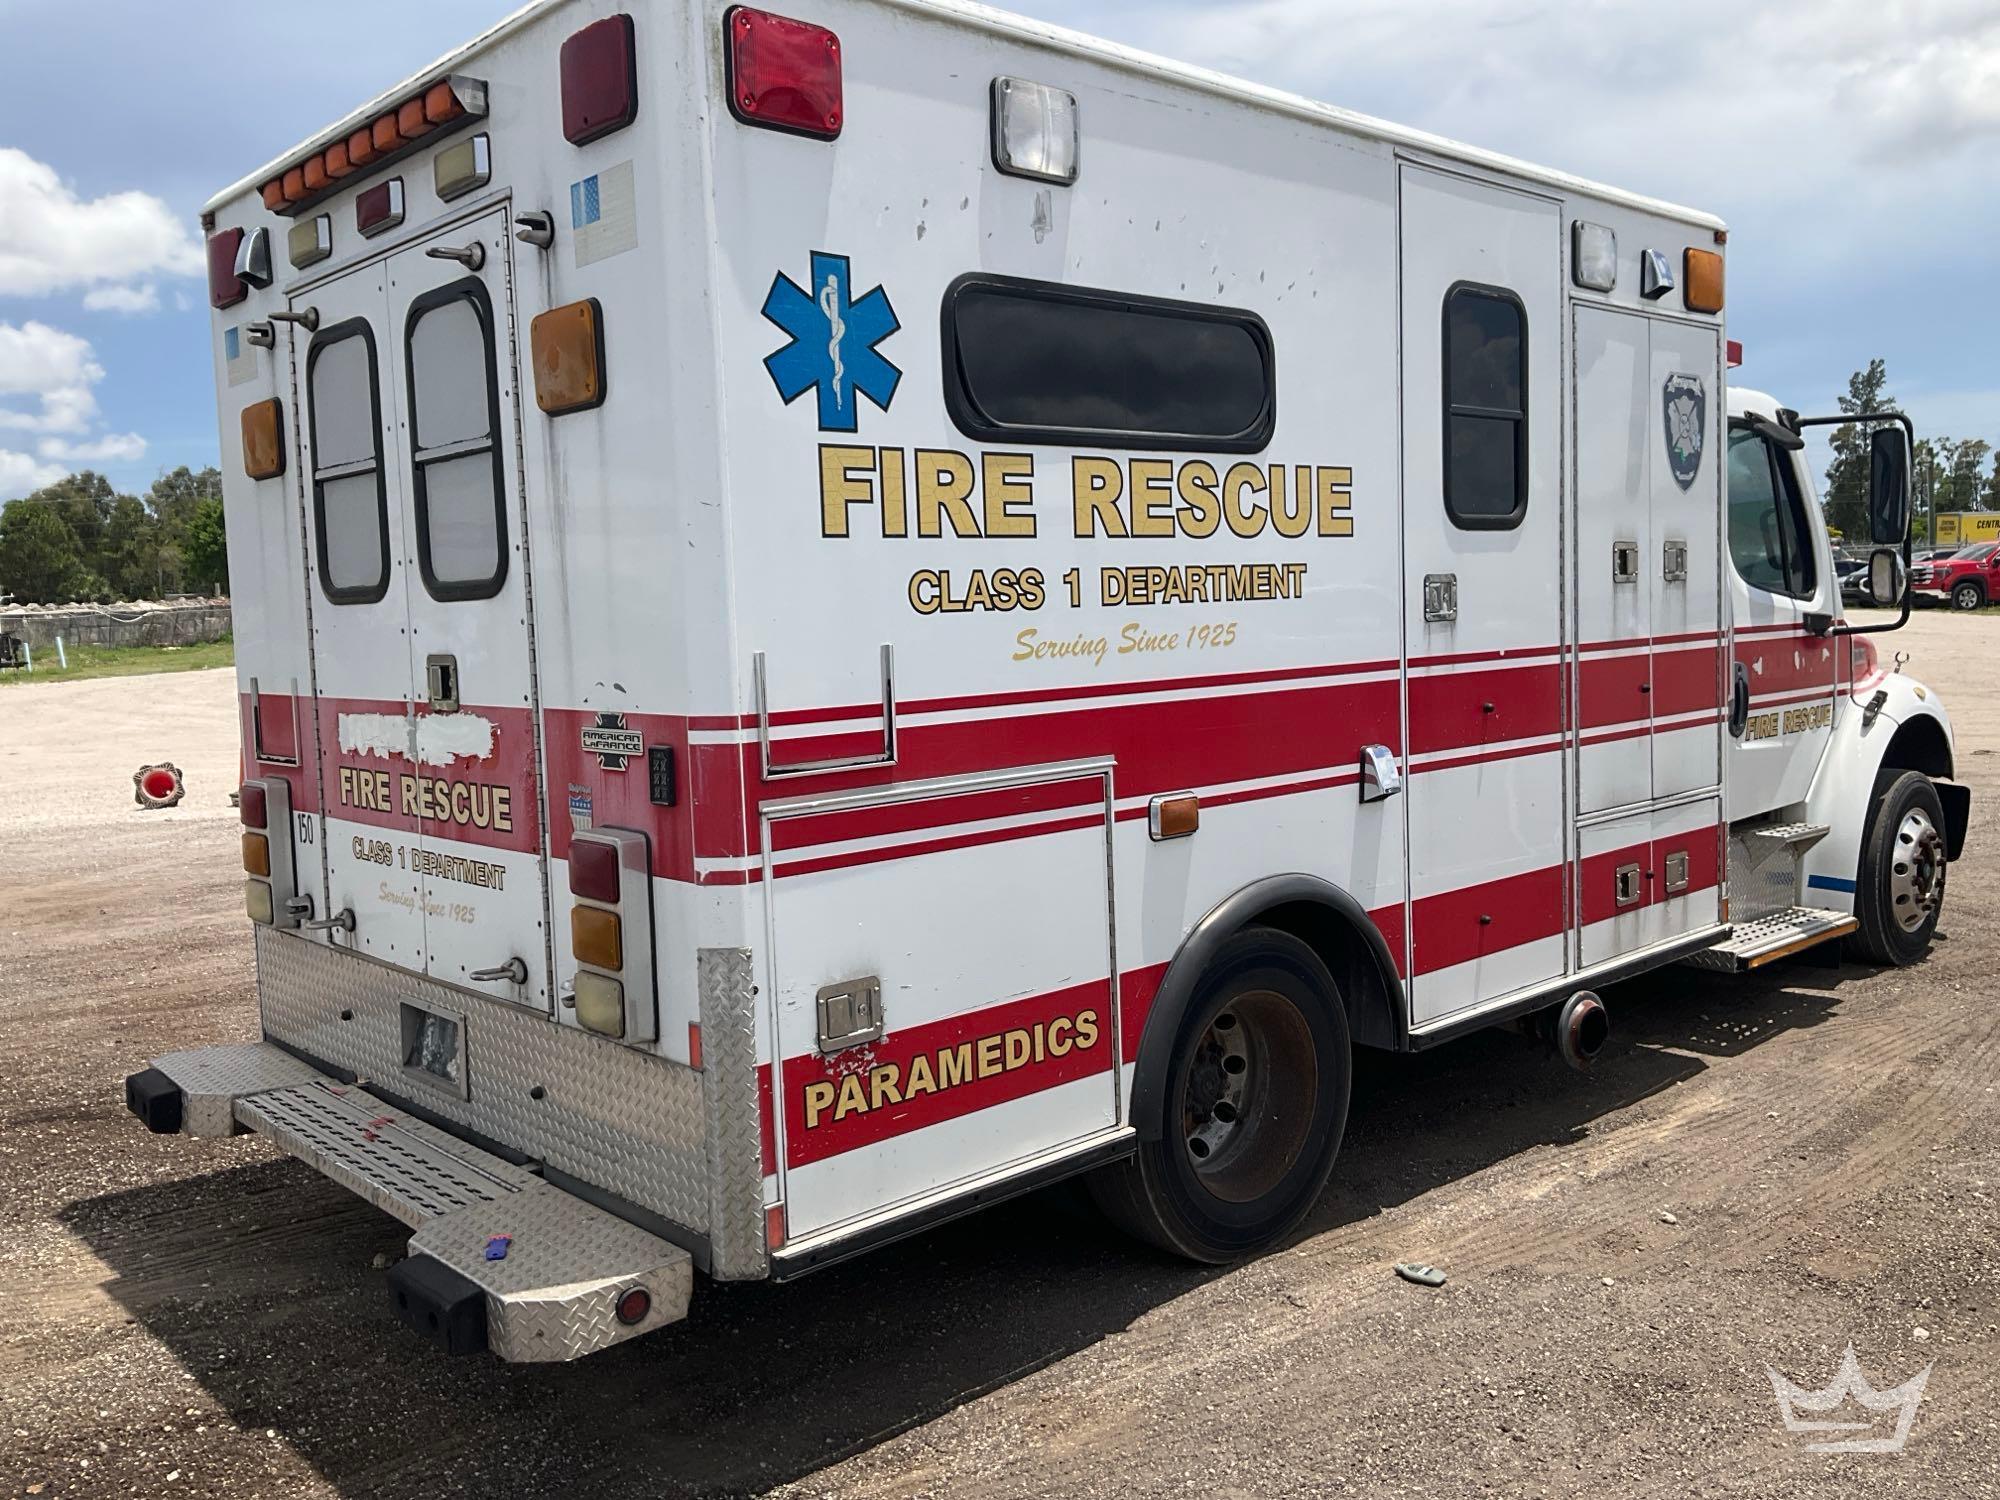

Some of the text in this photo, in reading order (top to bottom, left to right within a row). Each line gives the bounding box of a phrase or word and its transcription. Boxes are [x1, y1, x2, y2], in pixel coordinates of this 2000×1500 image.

[817, 443, 1354, 539] FIRE RESCUE
[1976, 519, 2000, 529] CENTR
[907, 563, 1307, 615] CLASS 1 DEPARTMENT
[1012, 622, 1238, 667] Serving Since 1925
[582, 731, 641, 743] AMERICAN
[1745, 703, 1832, 741] FIRE RESCUE
[339, 766, 513, 833] FIRE RESCUE
[297, 812, 314, 844] 150
[352, 835, 506, 891] CLASS 1 DEPARTMENT
[379, 881, 476, 924] Serving Since 1925
[804, 1010, 1099, 1129] PARAMEDICS
